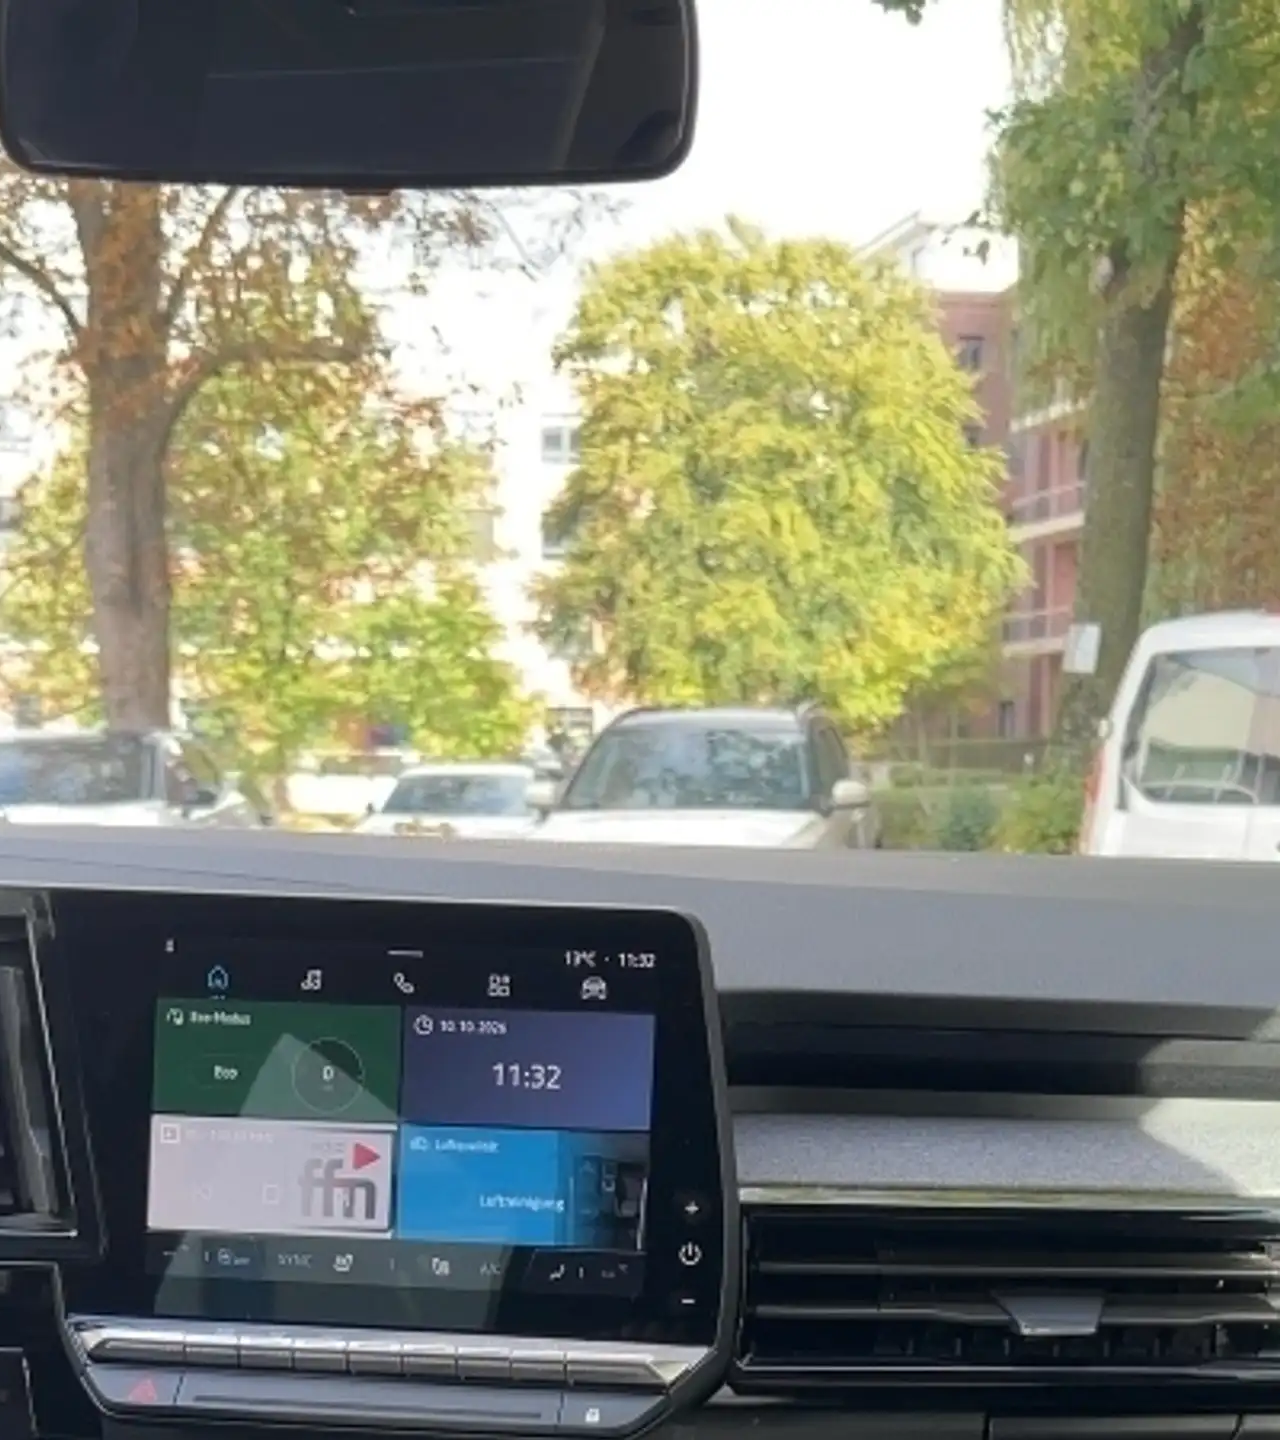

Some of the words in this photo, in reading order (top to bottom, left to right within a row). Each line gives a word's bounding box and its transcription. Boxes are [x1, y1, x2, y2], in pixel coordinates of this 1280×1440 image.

[618, 952, 657, 969] 11:32
[213, 1064, 239, 1081] Eco
[492, 1061, 563, 1091] 11:32
